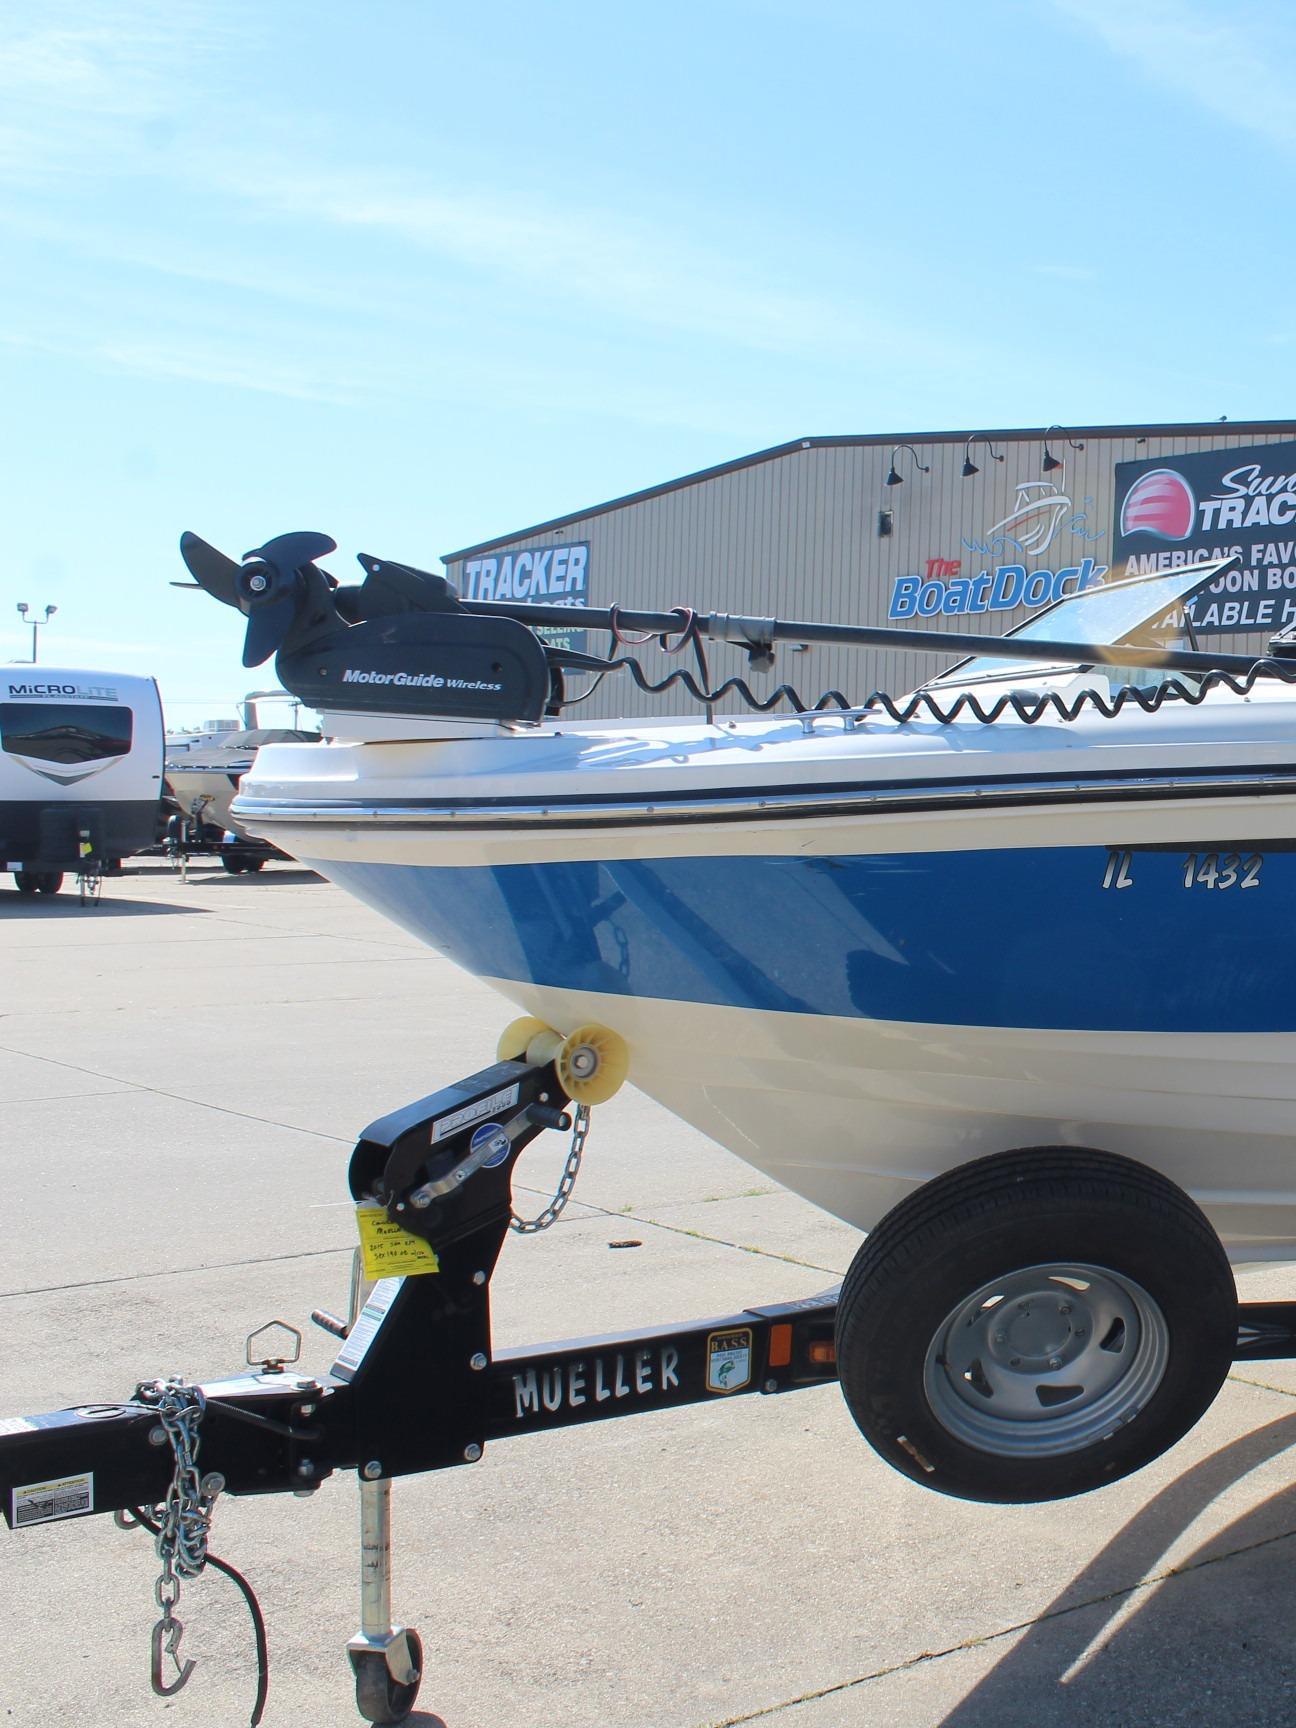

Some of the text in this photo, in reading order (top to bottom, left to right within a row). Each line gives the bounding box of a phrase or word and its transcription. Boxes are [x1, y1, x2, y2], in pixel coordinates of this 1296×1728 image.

[466, 546, 588, 600] TRACKER
[925, 558, 961, 579] The
[342, 669, 503, 691] MotorGuide Wireless
[1102, 851, 1133, 888] IL
[1182, 852, 1264, 889] 1432
[511, 1345, 680, 1418] MUELLER
